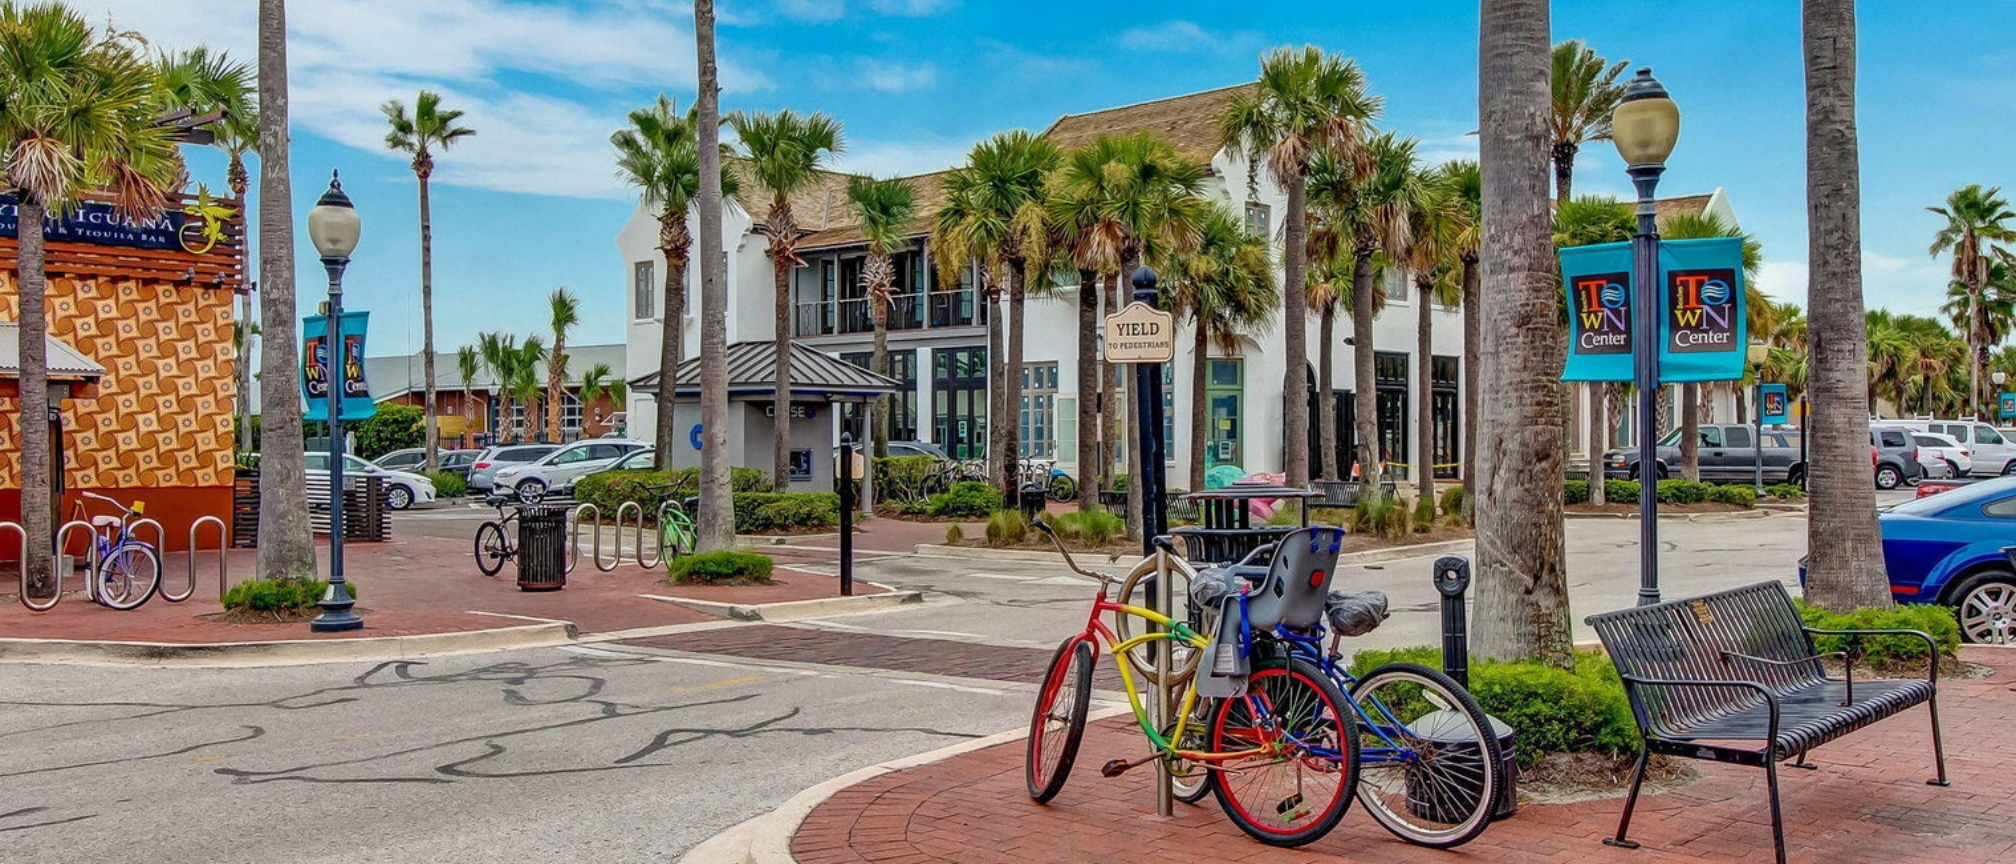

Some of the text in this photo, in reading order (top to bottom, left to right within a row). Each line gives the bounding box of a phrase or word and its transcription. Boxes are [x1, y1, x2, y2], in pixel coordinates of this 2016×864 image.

[76, 208, 175, 232] IGUANA
[75, 228, 134, 240] TEQUILA
[141, 233, 166, 243] BAR
[1116, 321, 1160, 336] YIELD
[1120, 340, 1170, 350] PEDESTRIANS
[1581, 332, 1627, 349] Center
[1675, 330, 1731, 347] Center
[766, 405, 806, 418] CSE
